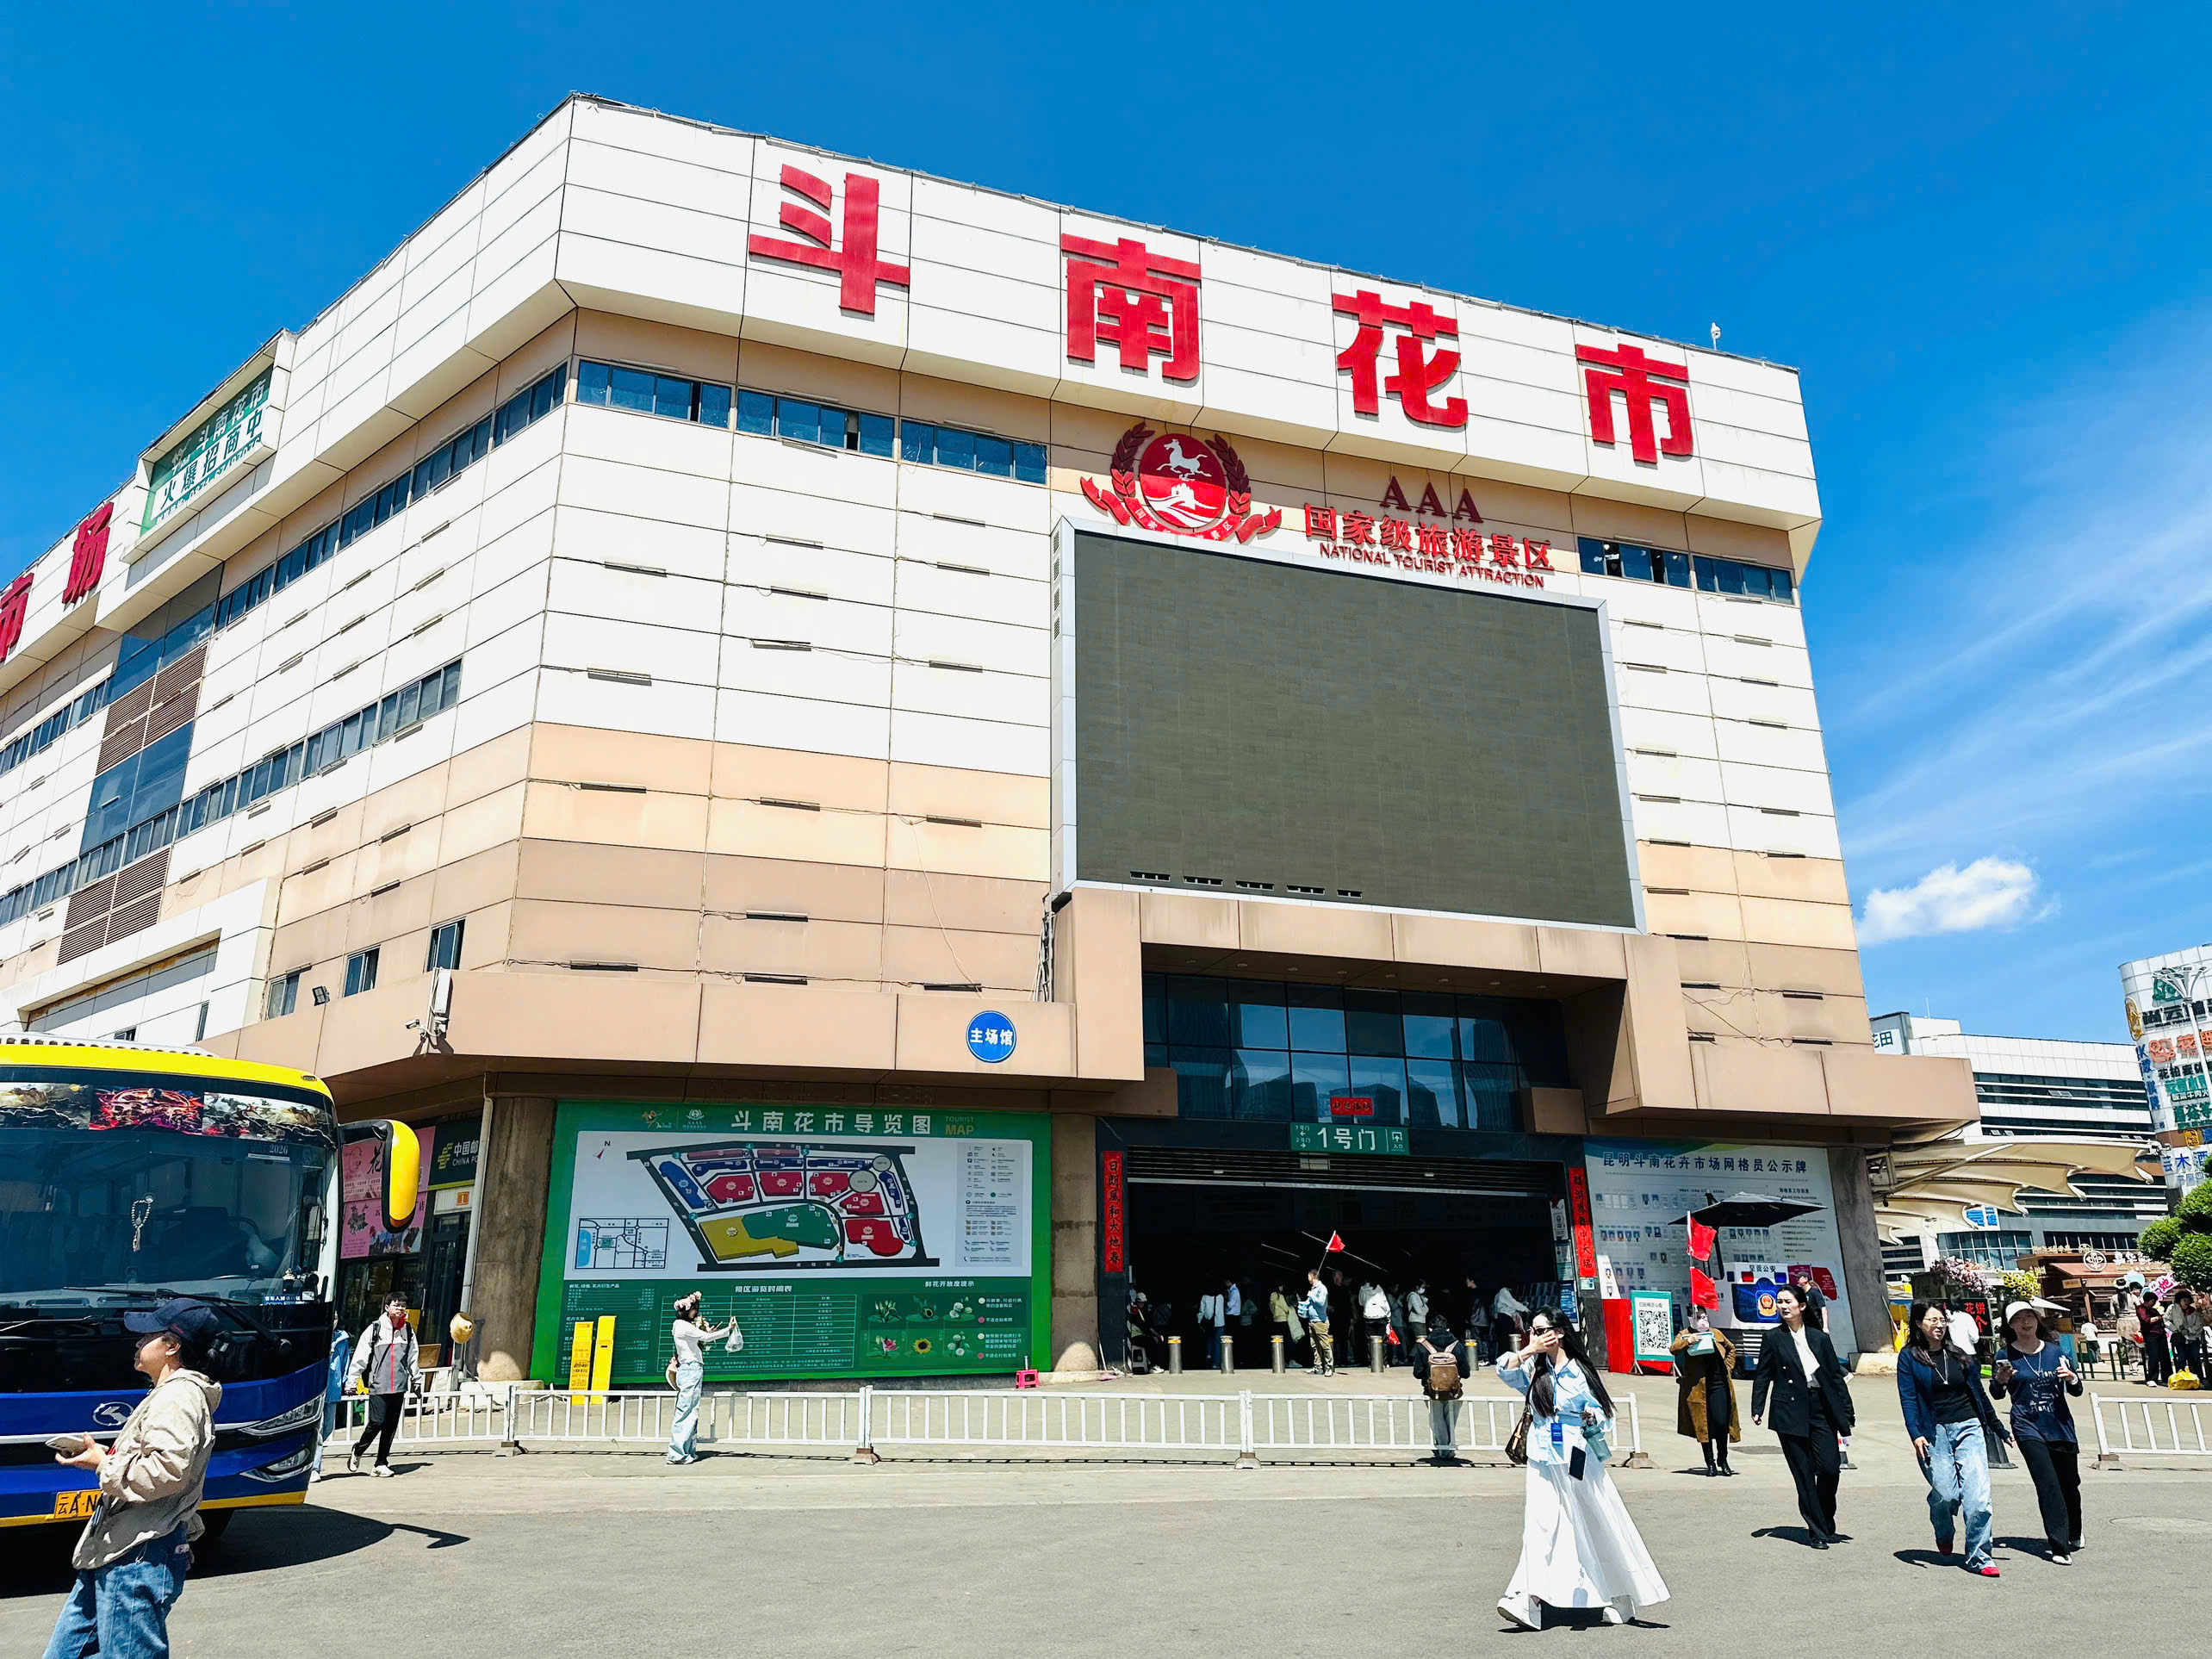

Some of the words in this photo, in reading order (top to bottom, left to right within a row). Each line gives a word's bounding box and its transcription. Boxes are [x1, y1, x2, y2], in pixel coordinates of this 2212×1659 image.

[749, 162, 1694, 465] 斗南花市
[196, 378, 267, 450] 斗南花市
[160, 408, 263, 510] 火爆招商中
[1379, 475, 1484, 524] AAA
[1303, 502, 1556, 571] 国家级旅游景区
[1320, 542, 1391, 565] NATIONAL
[1394, 554, 1455, 577] TOURIST
[1458, 562, 1545, 589] ATTRACTION
[970, 1028, 1014, 1046] 主场馆
[730, 1110, 931, 1135] 斗南花市导览图
[945, 1124, 975, 1135] MAP
[269, 1144, 289, 1154] 2026
[1317, 1127, 1376, 1151] 1号门
[452, 1157, 469, 1166] CHINA
[1603, 1152, 1807, 1174] 昆明斗南花卉市场网格员公示牌
